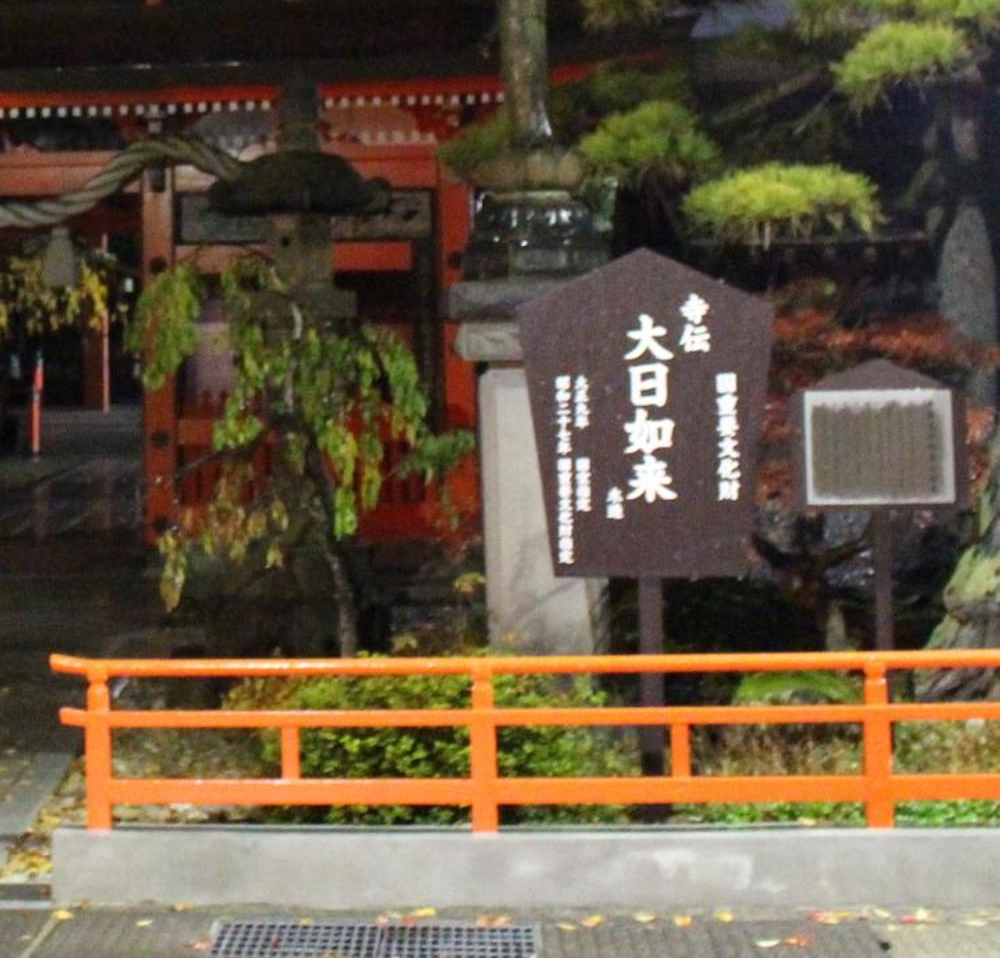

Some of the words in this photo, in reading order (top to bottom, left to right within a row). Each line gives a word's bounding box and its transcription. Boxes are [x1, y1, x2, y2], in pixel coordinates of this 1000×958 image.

[678, 292, 711, 353] 寺伝
[623, 313, 678, 504] 大日如来
